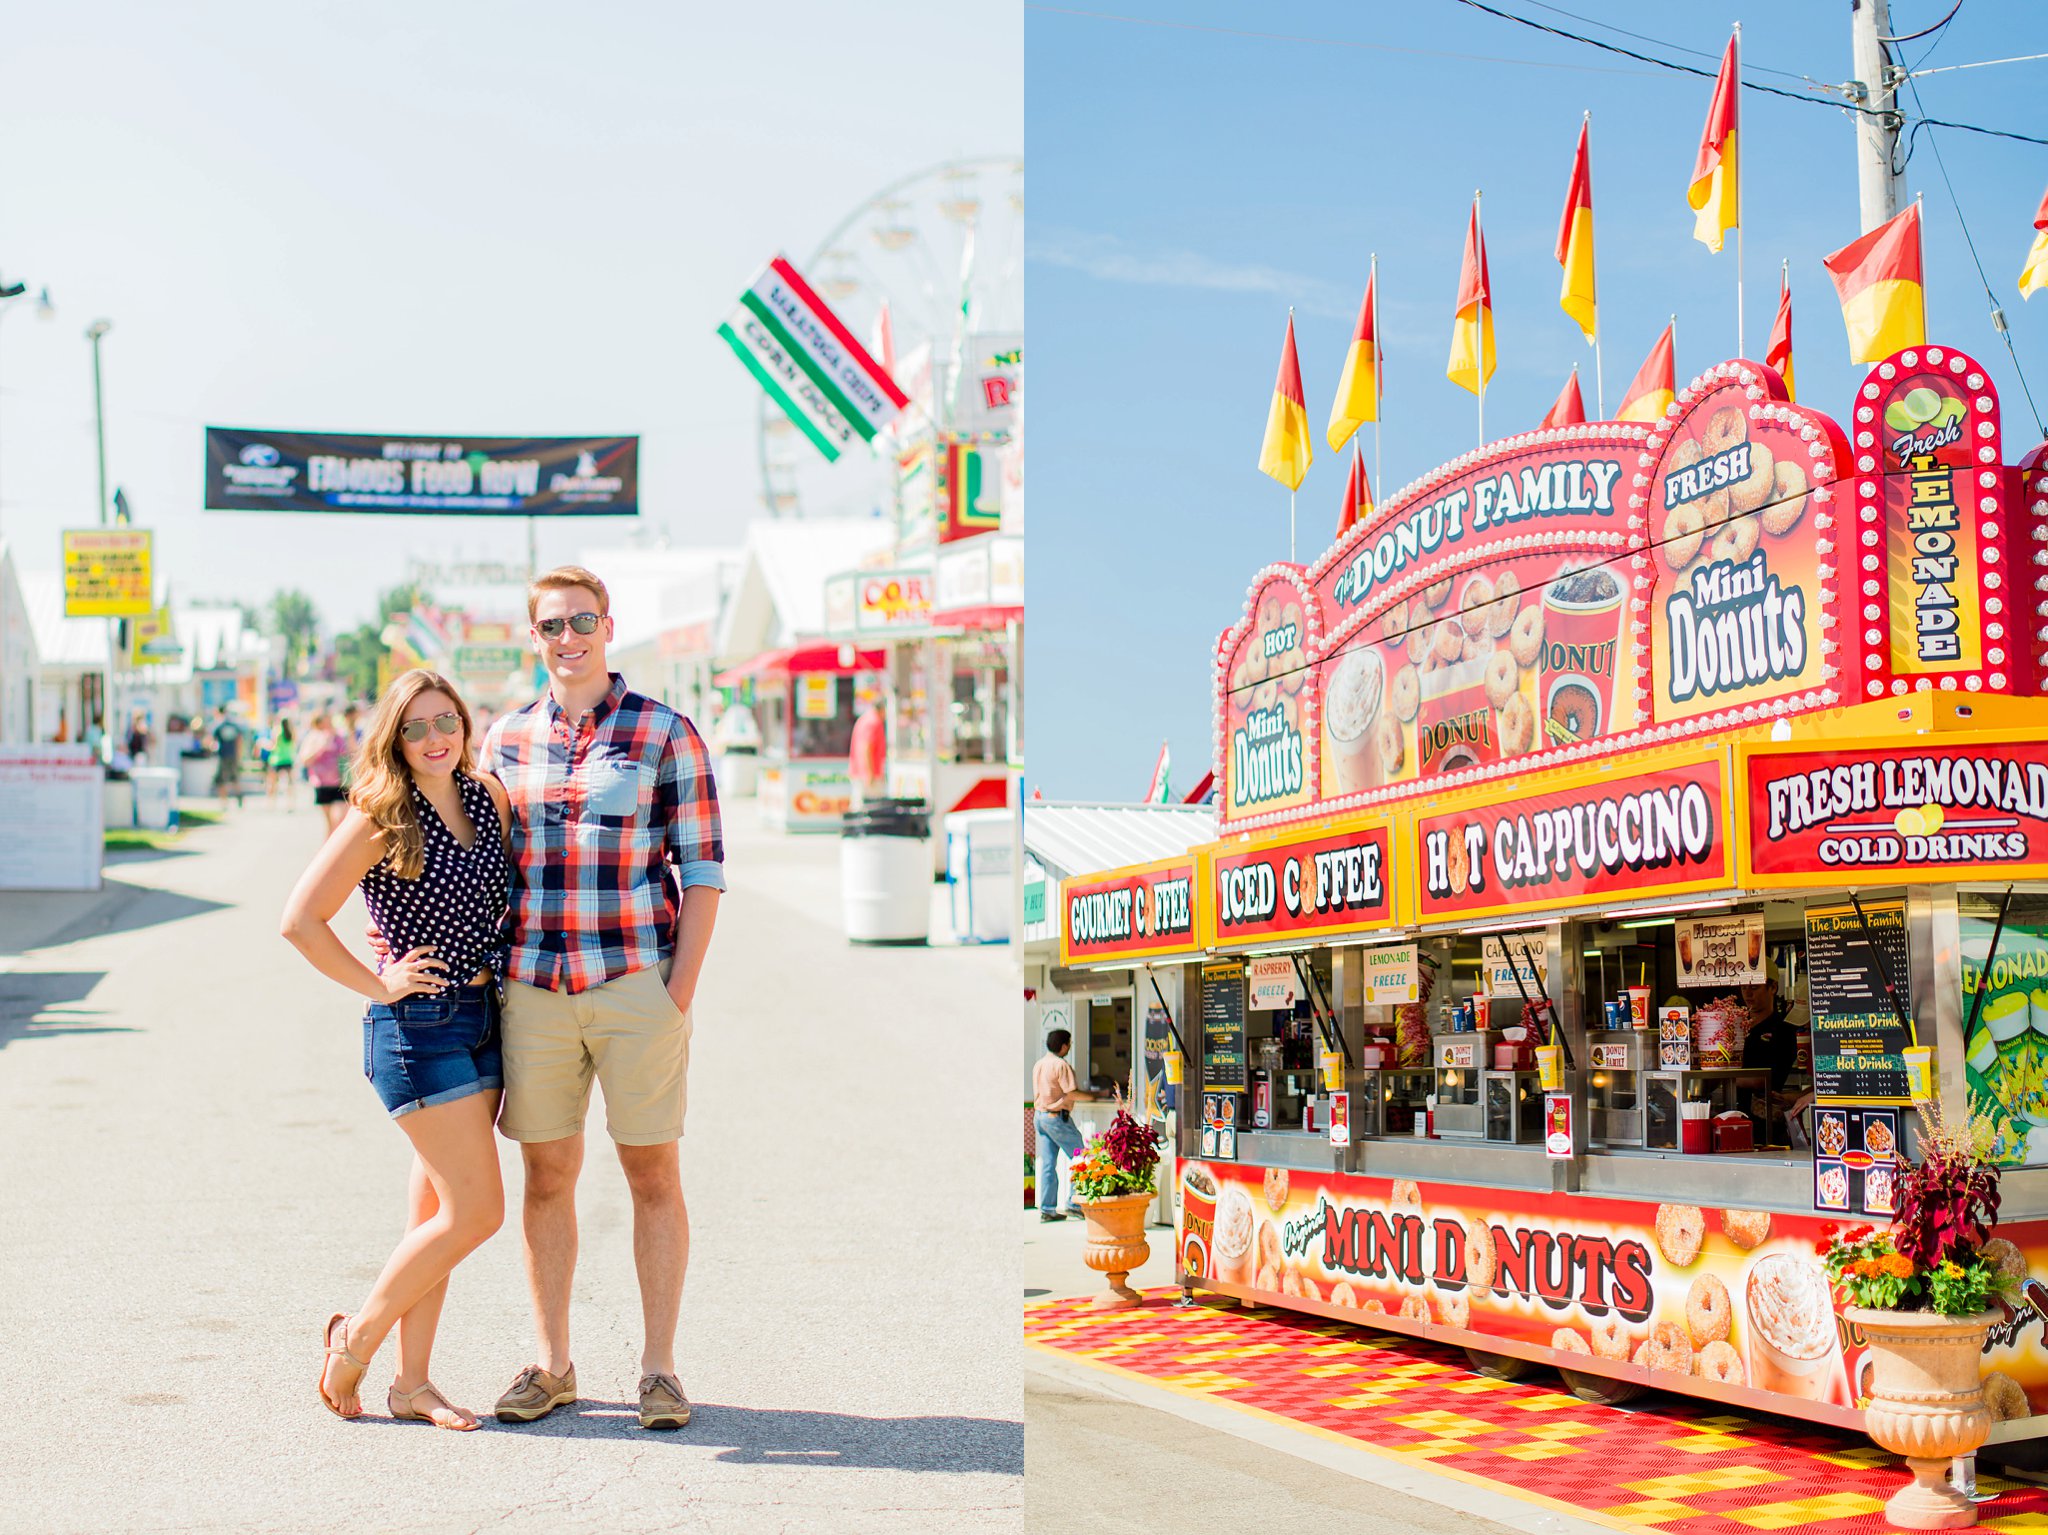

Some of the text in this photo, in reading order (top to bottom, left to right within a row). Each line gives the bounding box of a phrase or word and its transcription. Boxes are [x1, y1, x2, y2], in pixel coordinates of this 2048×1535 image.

[744, 321, 850, 442] CORN DOGS
[841, 367, 883, 413] CHIPS
[1892, 416, 1960, 467] Fresh
[308, 455, 405, 493] FAMOUS
[411, 459, 473, 495] FOOD
[480, 459, 540, 496] ROW
[1666, 446, 1750, 506] FRESH
[1351, 490, 1468, 602] DONUT
[1473, 462, 1620, 527] FAMILY
[1909, 456, 1959, 660] LEMONADE
[865, 577, 935, 606] COR
[1694, 555, 1765, 609] Mini
[1264, 625, 1296, 657] HOT
[1541, 637, 1618, 678] DONUT
[1668, 581, 1806, 698] Donuts
[1247, 703, 1284, 742] Mini
[1421, 706, 1491, 767] DONUT
[1234, 723, 1302, 804] Donuts
[1768, 761, 1877, 838] FRESH
[1494, 782, 1708, 881] CAPPUCCINO
[1819, 833, 2026, 863] COLD DRINKS
[1220, 863, 1276, 921] ICED
[1071, 889, 1132, 941] GOURMET
[1693, 919, 1745, 940] Flavored
[1810, 911, 1903, 932] The Donu Family
[1369, 951, 1411, 966] LEMONADE
[1695, 957, 1746, 978] Coffee
[1702, 937, 1736, 959] Iced
[1253, 961, 1292, 977] RASPBERRY
[1373, 973, 1407, 988] FREEZE
[1494, 966, 1535, 981] FREZE
[1961, 948, 2048, 995] EMONAD
[1206, 1023, 1225, 1033] Fountain
[1818, 1013, 1902, 1029] Fountain Drink
[1212, 1054, 1236, 1064] Hot Drinks
[1606, 1045, 1625, 1056] DONUT
[1606, 1057, 1625, 1067] FAMILY
[1836, 1055, 1893, 1071] Hot Drinks
[1284, 1196, 1327, 1255] Original
[1324, 1206, 1424, 1281] MINI
